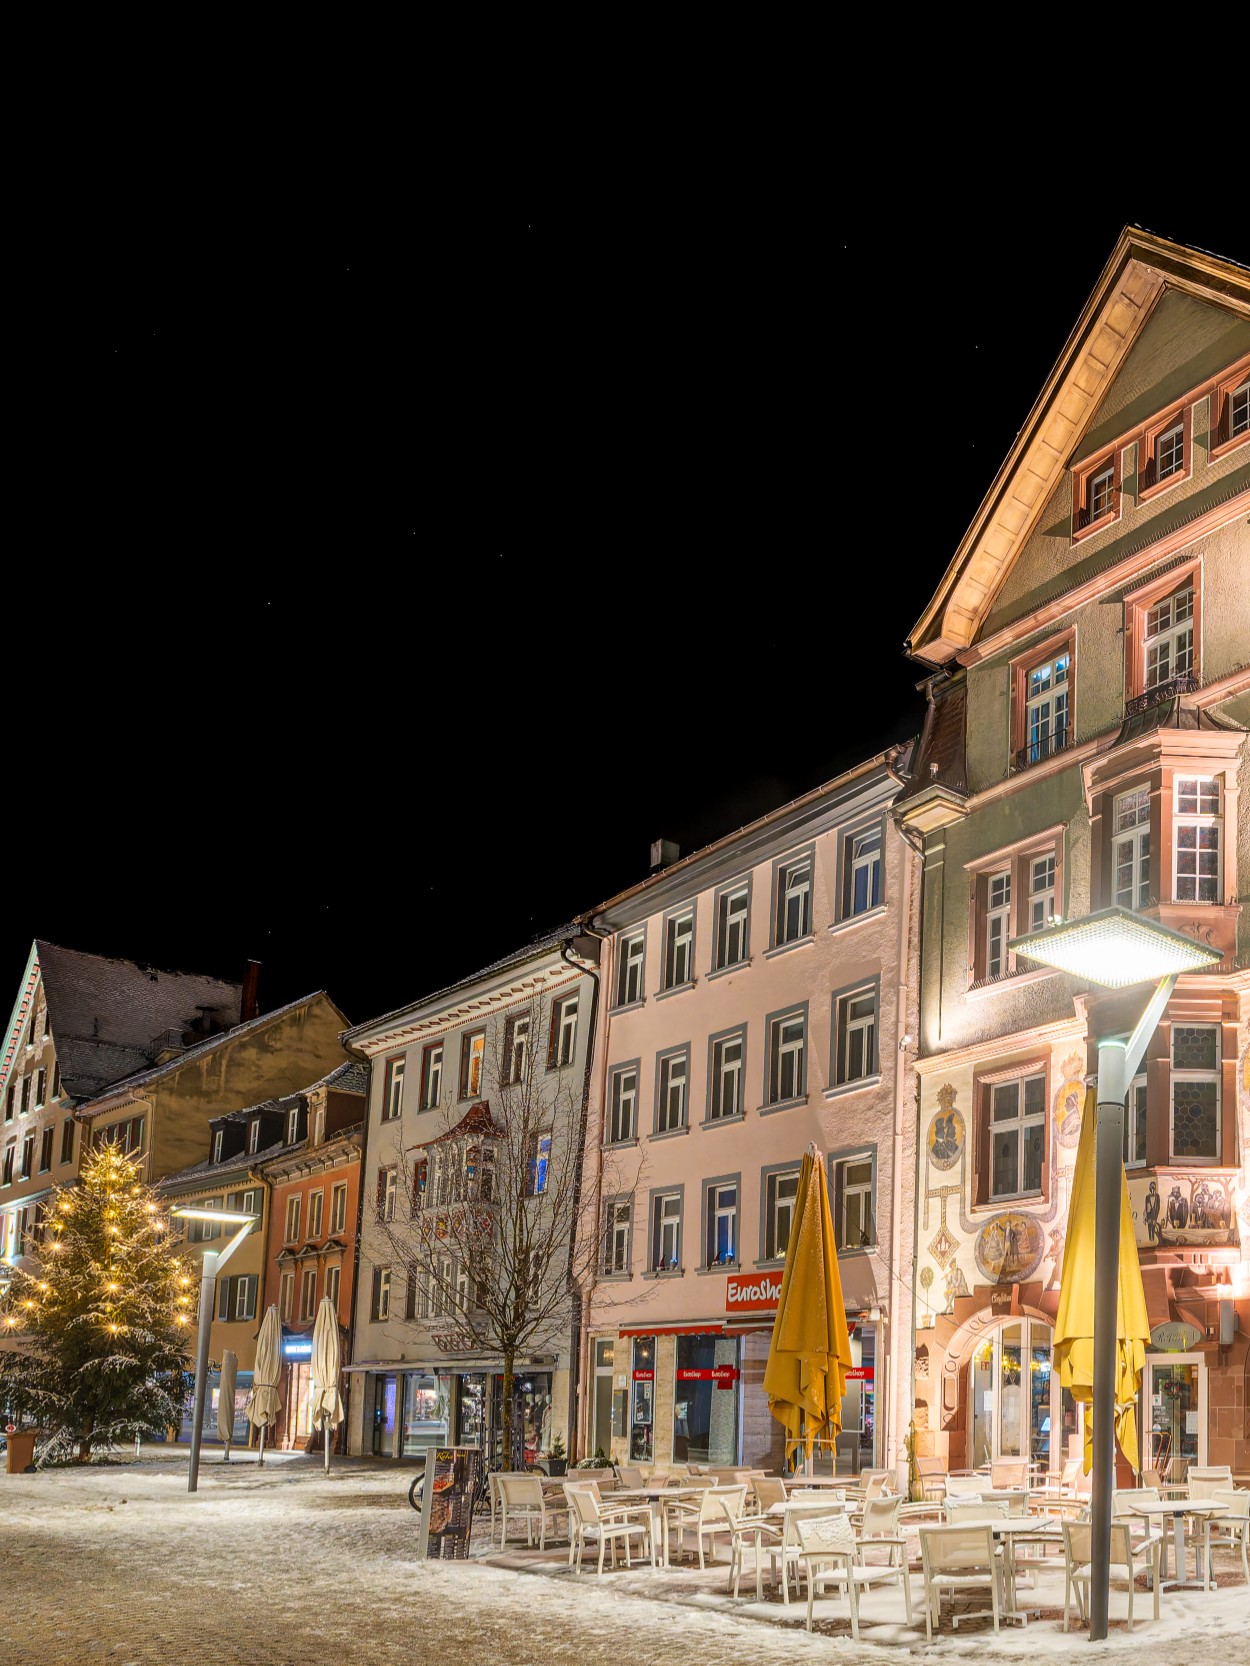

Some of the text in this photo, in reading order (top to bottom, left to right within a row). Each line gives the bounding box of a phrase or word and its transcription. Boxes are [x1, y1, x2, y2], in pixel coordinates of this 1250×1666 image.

[727, 1278, 783, 1303] EuroSho
[683, 1370, 730, 1379] EuroShop EuroShop
